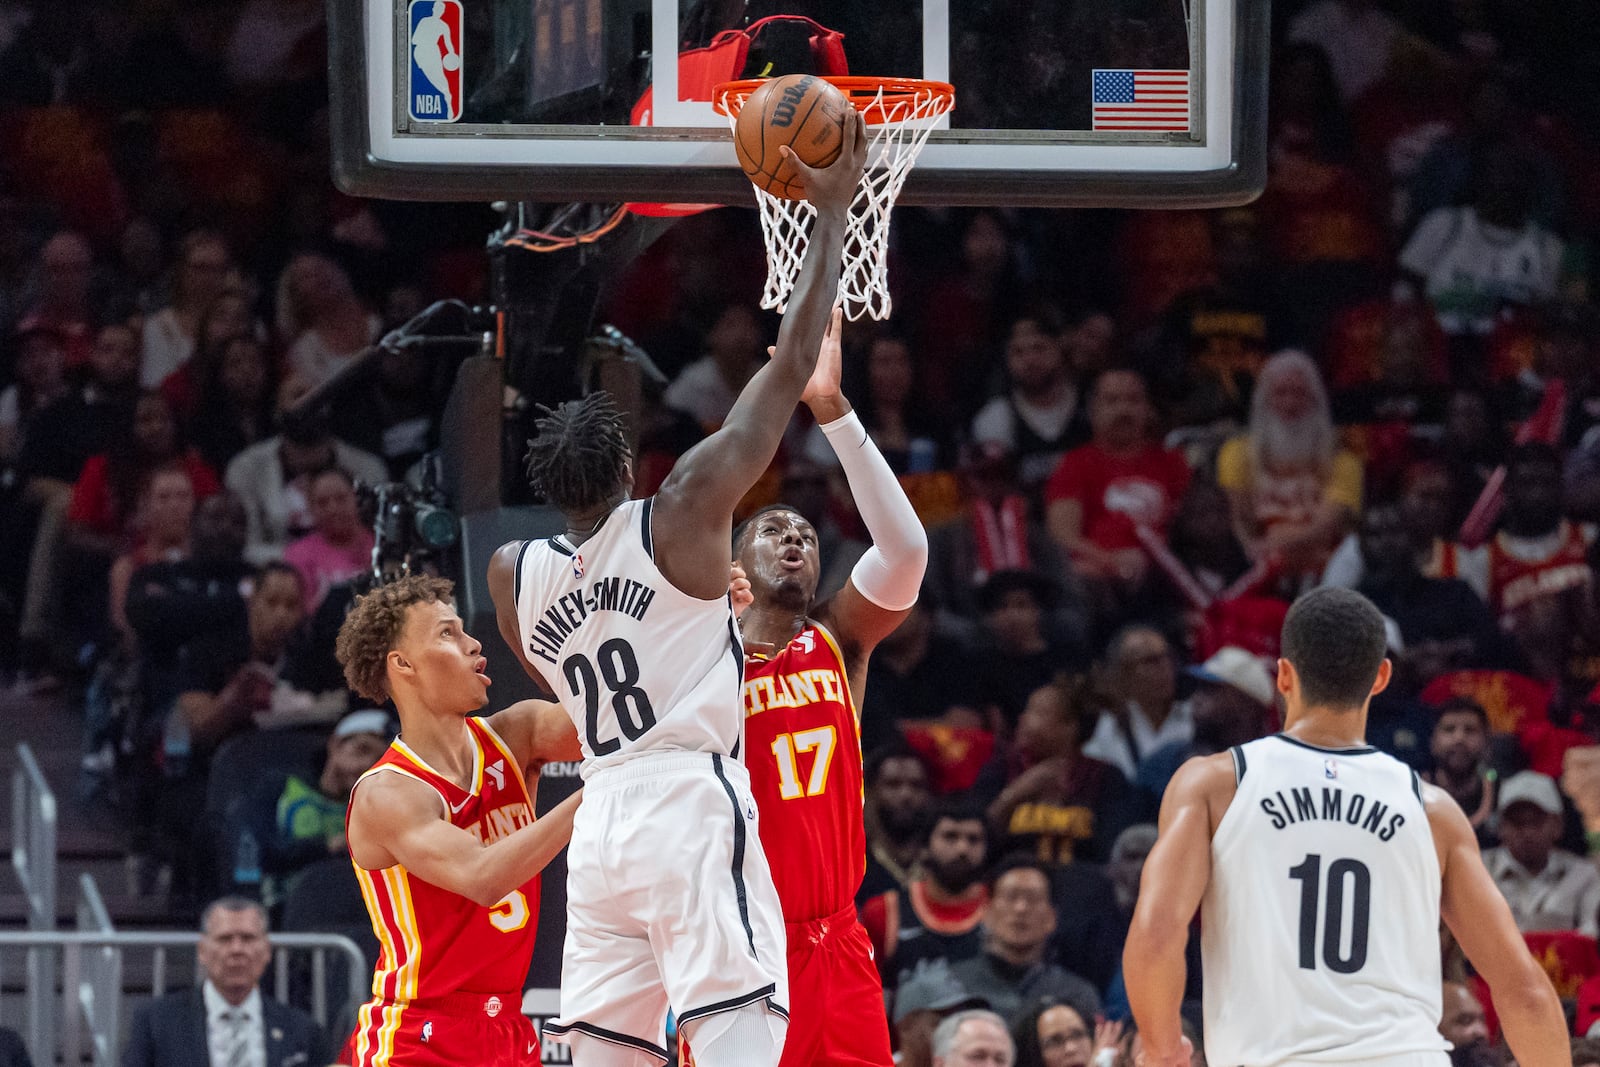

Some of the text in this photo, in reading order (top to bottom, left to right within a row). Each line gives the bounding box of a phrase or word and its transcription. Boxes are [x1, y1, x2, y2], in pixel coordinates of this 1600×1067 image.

[416, 94, 442, 114] NBA
[529, 576, 656, 665] FINNEY-SMITH
[562, 637, 657, 757] 28
[745, 669, 846, 719] TLANT
[770, 724, 838, 801] 17
[1260, 786, 1405, 843] SIMMONS
[488, 889, 531, 934] 5
[1288, 853, 1371, 974] 10
